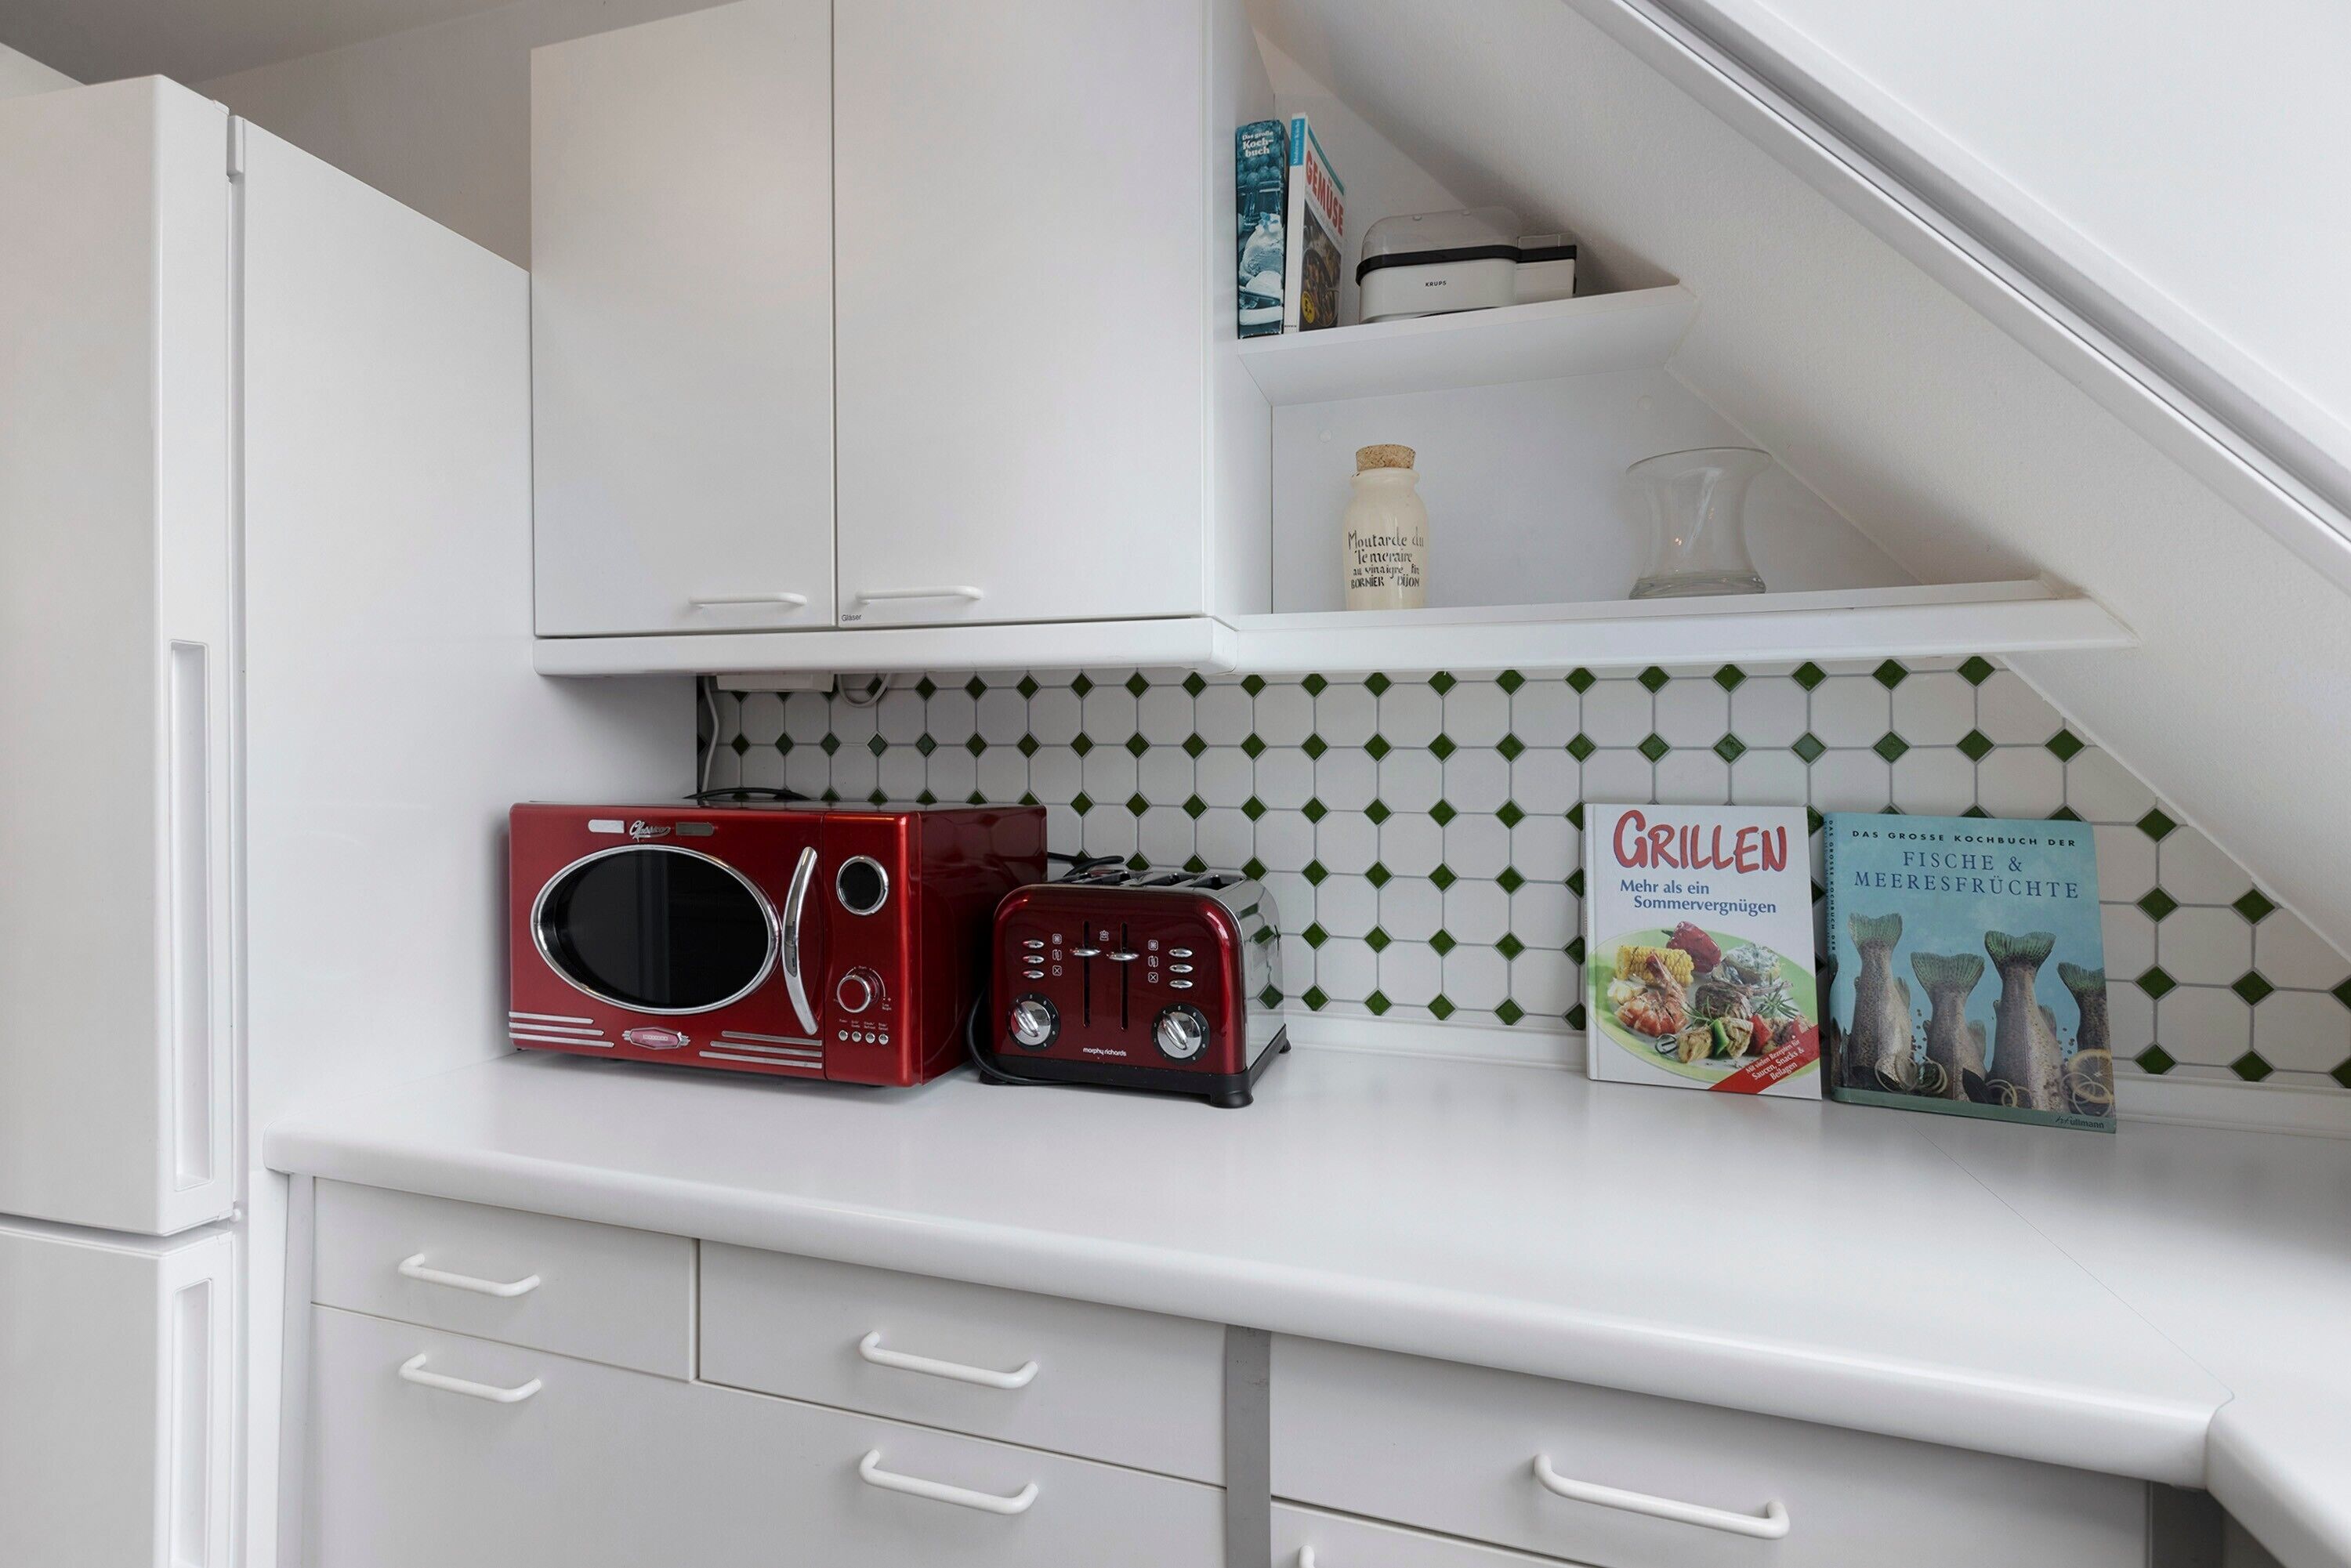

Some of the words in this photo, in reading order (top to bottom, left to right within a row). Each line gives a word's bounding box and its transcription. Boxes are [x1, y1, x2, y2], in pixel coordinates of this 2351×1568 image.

[1255, 130, 1273, 139] große
[1243, 138, 1273, 150] Koch-
[1245, 146, 1270, 157] buch
[1306, 150, 1344, 237] GEMÜSE
[1348, 527, 1407, 550] Moutarde
[1412, 527, 1424, 547] du
[1365, 564, 1404, 579] vinaigre
[1351, 575, 1385, 589] BORNIER
[1613, 809, 1787, 874] GRILLEN
[1852, 830, 1878, 838] DAS
[1888, 832, 1945, 842] GROSSE
[1954, 835, 2038, 846] KOCHBUCH
[2048, 838, 2076, 847] DER
[1903, 851, 1994, 871] FISCHE
[2008, 856, 2022, 872] &
[1620, 879, 1658, 893] Mehr
[1663, 880, 1683, 894] als
[1687, 881, 1710, 894] ein
[1854, 871, 2078, 899] MEERESFRÜCHTE
[1634, 895, 1777, 917] Sommervergnügen
[1083, 1047, 1104, 1056] morphy
[1104, 1048, 1127, 1057] richards
[1745, 1065, 1756, 1074] Mit
[1755, 1057, 1771, 1068] vielen
[1769, 1044, 1792, 1060] Rezepten
[1791, 1039, 1800, 1047] für
[1751, 1064, 1777, 1080] Saucen,
[1775, 1051, 1798, 1066] Snacks
[1770, 1062, 1798, 1080] Beilagen
